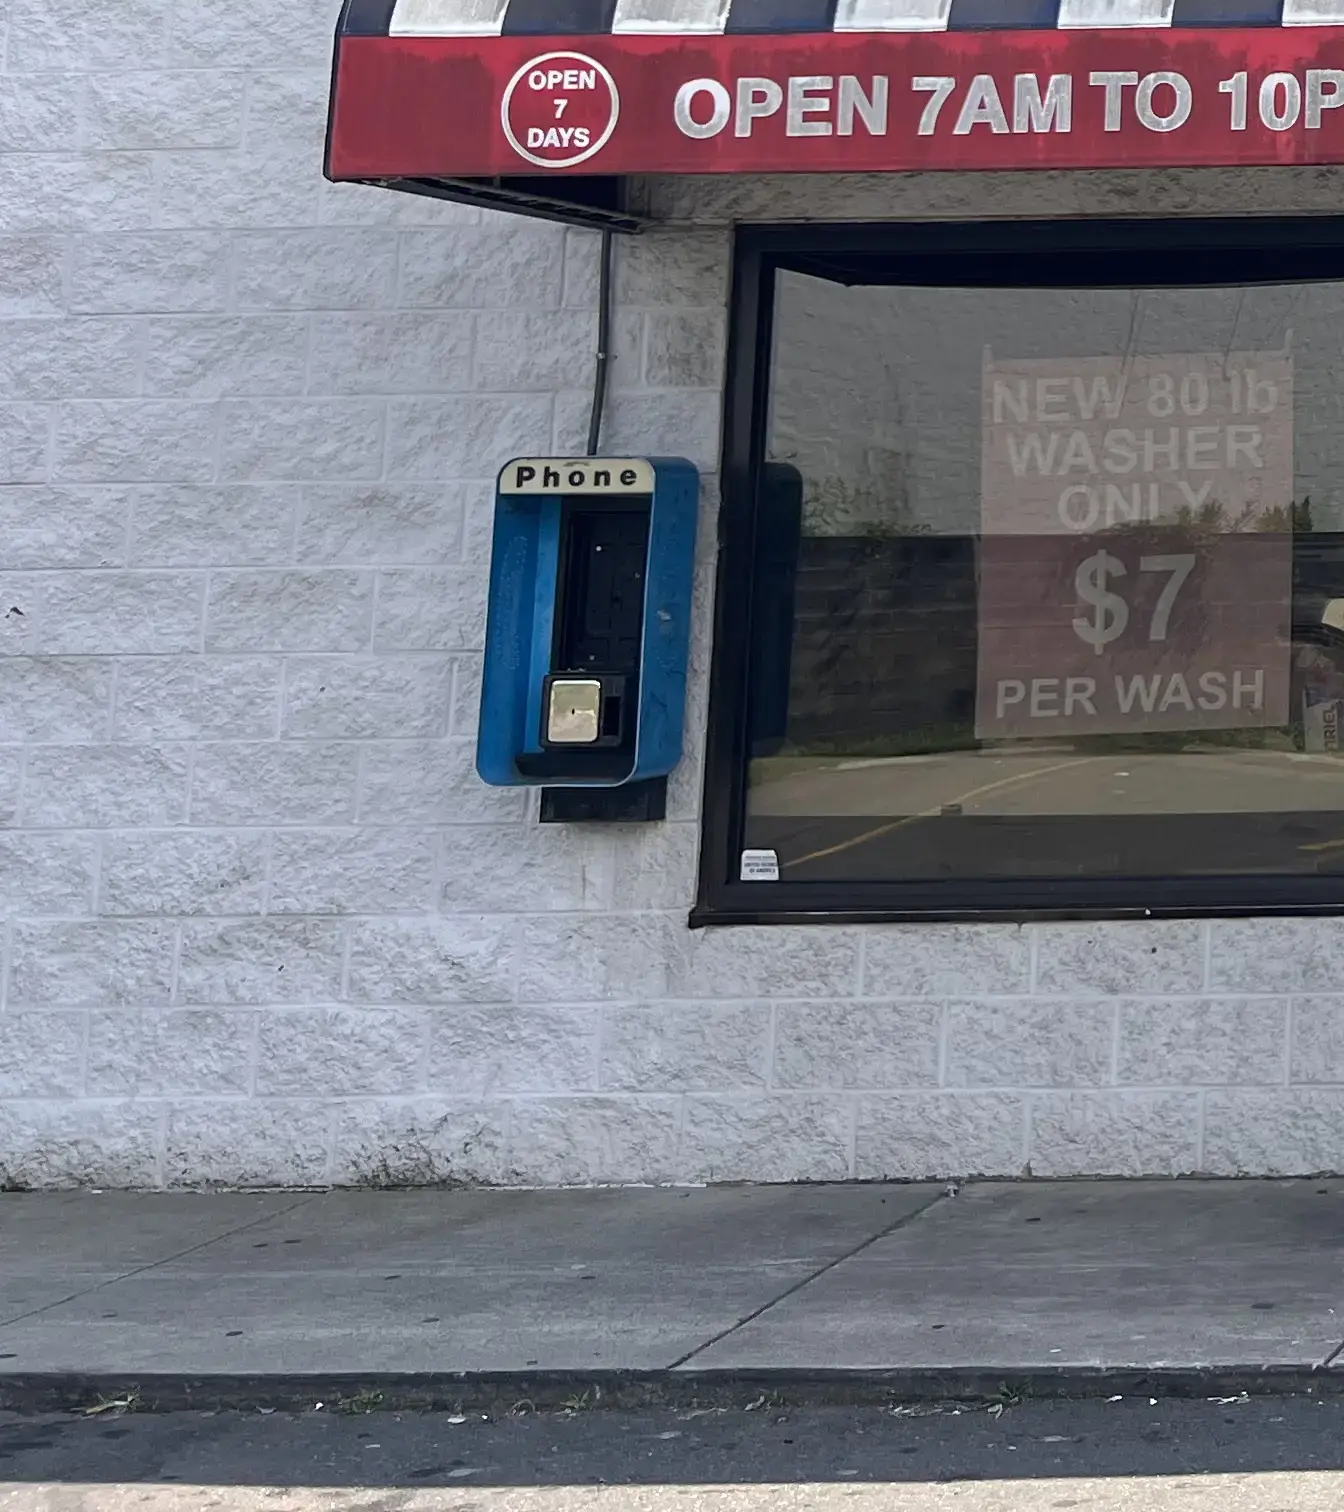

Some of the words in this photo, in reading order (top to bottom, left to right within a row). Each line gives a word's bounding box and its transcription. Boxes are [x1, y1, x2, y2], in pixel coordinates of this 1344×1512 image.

[527, 68, 597, 91] OPEN
[553, 98, 568, 120] 7
[674, 74, 887, 139] OPEN
[911, 73, 1073, 137] 7AM
[1089, 71, 1192, 133] TO
[526, 127, 592, 150] DAYS
[992, 375, 1127, 423] NEW
[1147, 372, 1210, 419] 80
[1006, 424, 1264, 477] WASHER
[515, 466, 638, 488] Phone
[1072, 549, 1196, 656] $7
[996, 676, 1098, 719] PER
[1115, 670, 1264, 714] WASH
